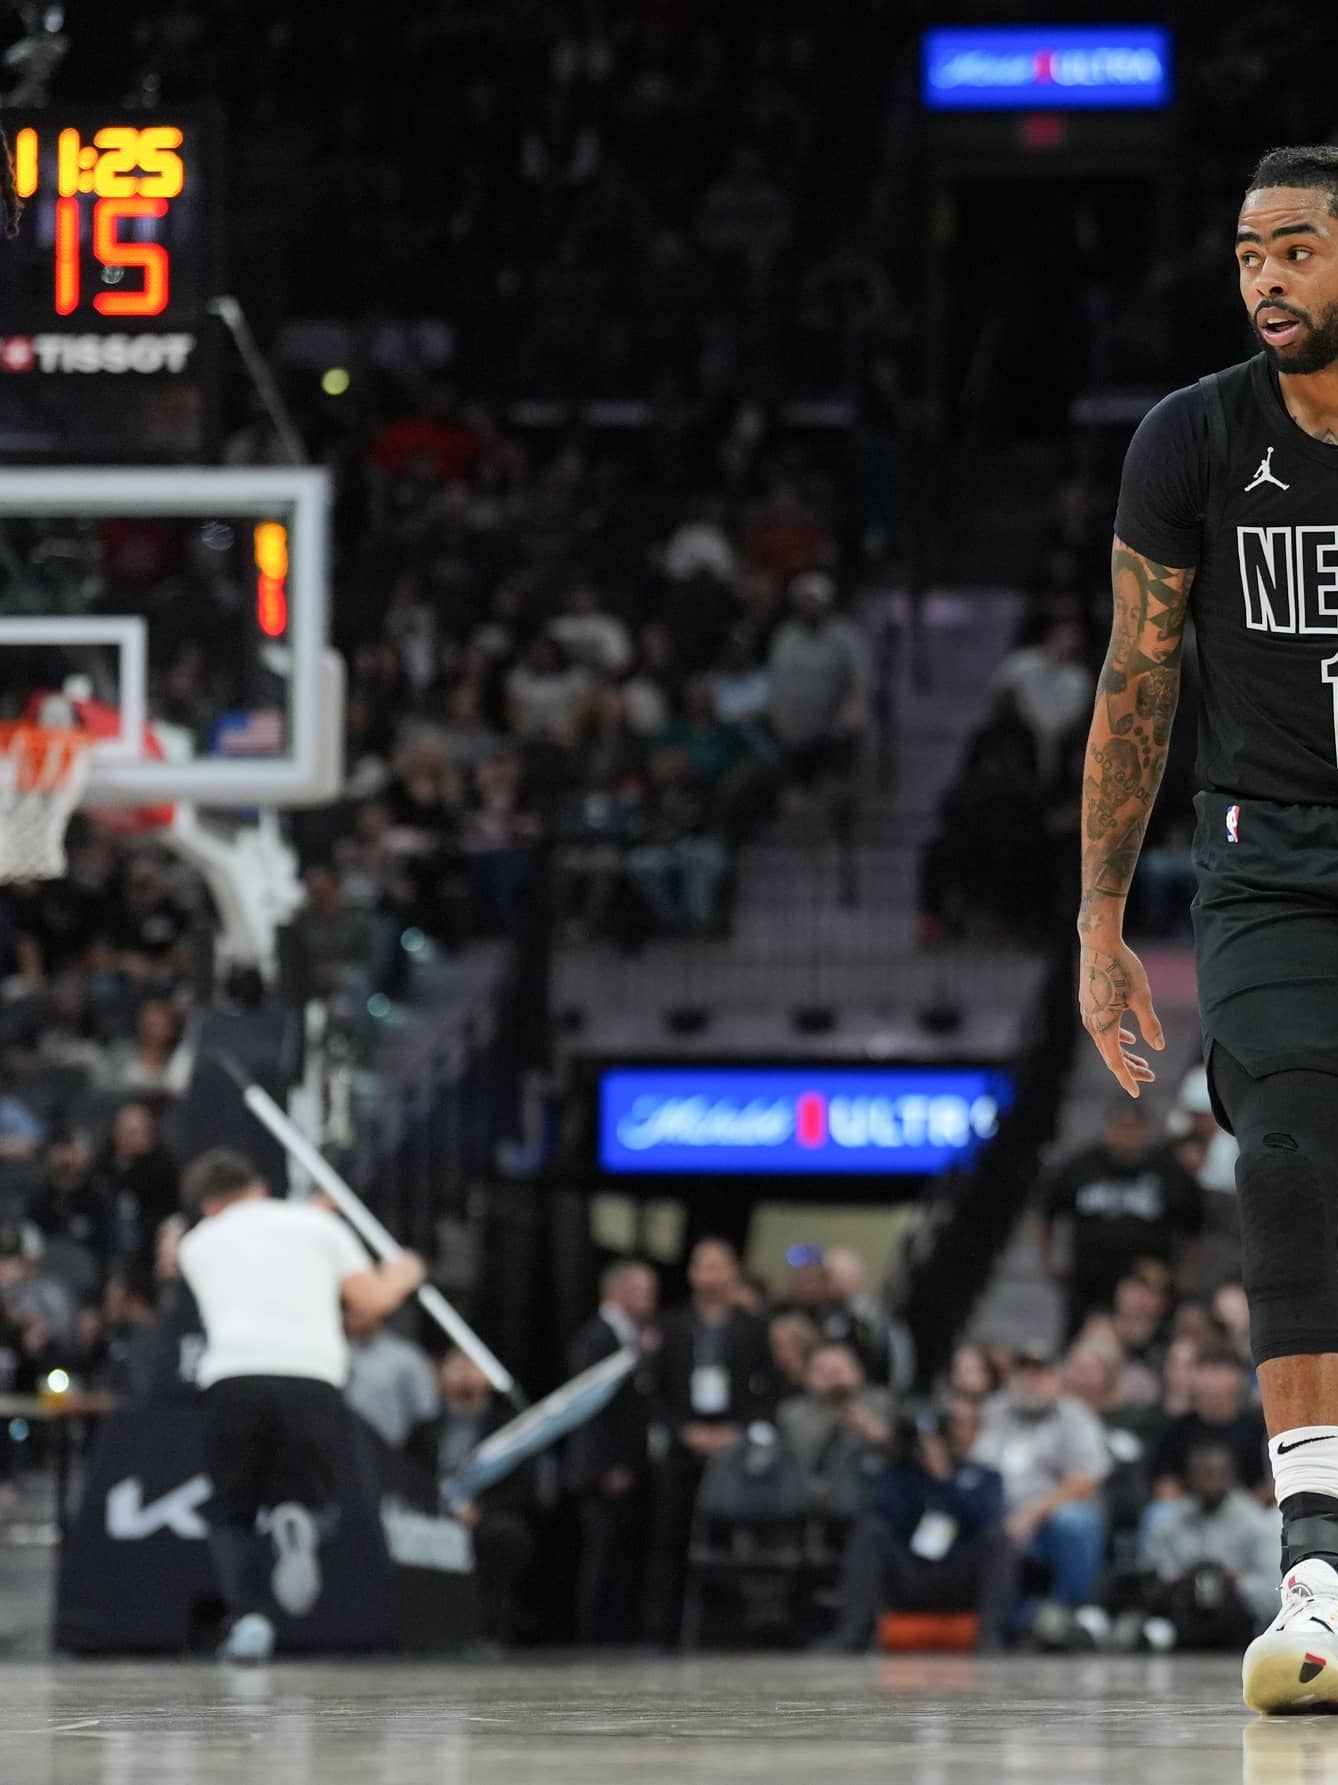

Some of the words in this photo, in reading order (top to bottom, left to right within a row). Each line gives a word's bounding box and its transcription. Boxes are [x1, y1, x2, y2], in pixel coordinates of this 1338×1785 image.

[16, 127, 184, 198] 11:25
[55, 197, 169, 316] 15
[36, 333, 194, 374] TISSOT
